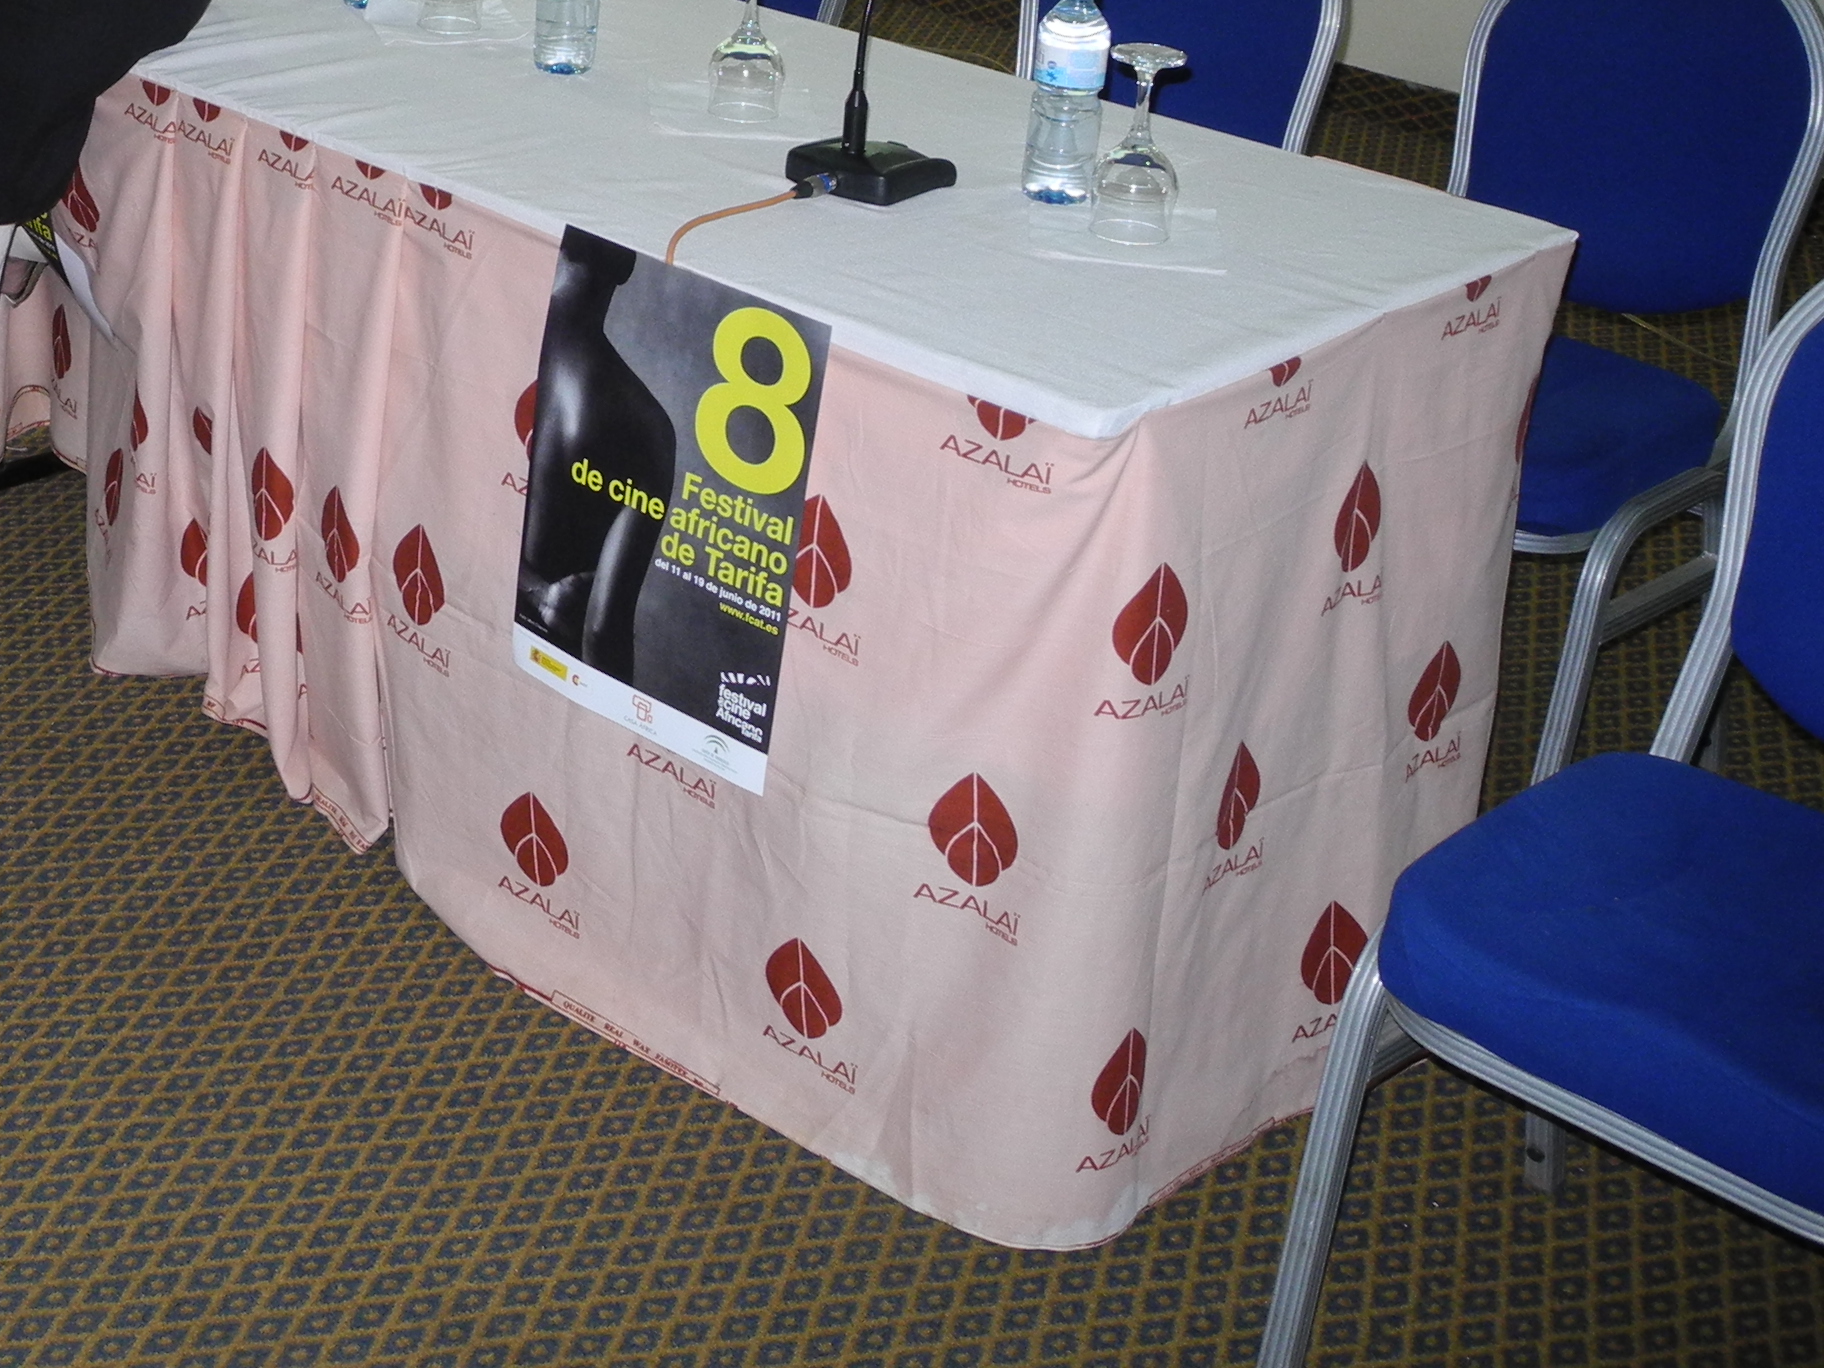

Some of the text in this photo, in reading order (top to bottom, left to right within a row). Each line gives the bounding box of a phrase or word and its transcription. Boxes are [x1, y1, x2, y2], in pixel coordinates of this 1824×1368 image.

[124, 102, 177, 134] AZALA
[177, 120, 236, 157] AZALAÏ
[330, 175, 406, 219] AZALAÏ
[404, 205, 476, 251] AZALAÏ
[1440, 295, 1503, 341] AZALAÏ
[694, 306, 813, 496] 8
[1243, 377, 1314, 430] AZALAÏ
[939, 433, 1055, 485] AZALAÏ
[571, 458, 604, 492] de
[608, 478, 666, 521] cine
[669, 506, 789, 576] africano
[681, 471, 795, 546] Festival
[654, 558, 782, 622] del 11 al 19 de junio de 2011
[660, 531, 786, 608] de Tarifa
[719, 601, 780, 636] www.fcat.es
[1320, 574, 1382, 617] AZALA
[387, 613, 452, 668] AZALAÏ
[786, 606, 862, 657] ZALAÏ
[718, 683, 768, 717] festival
[724, 699, 751, 720] cine
[1093, 674, 1190, 720] AZALAÏ
[626, 743, 717, 800] AZALAÏ
[498, 875, 581, 930] AZALAÏ
[913, 882, 1022, 936] AZALAÏ
[603, 1022, 624, 1039] REAL
[762, 1024, 859, 1085] AZALAÏ
